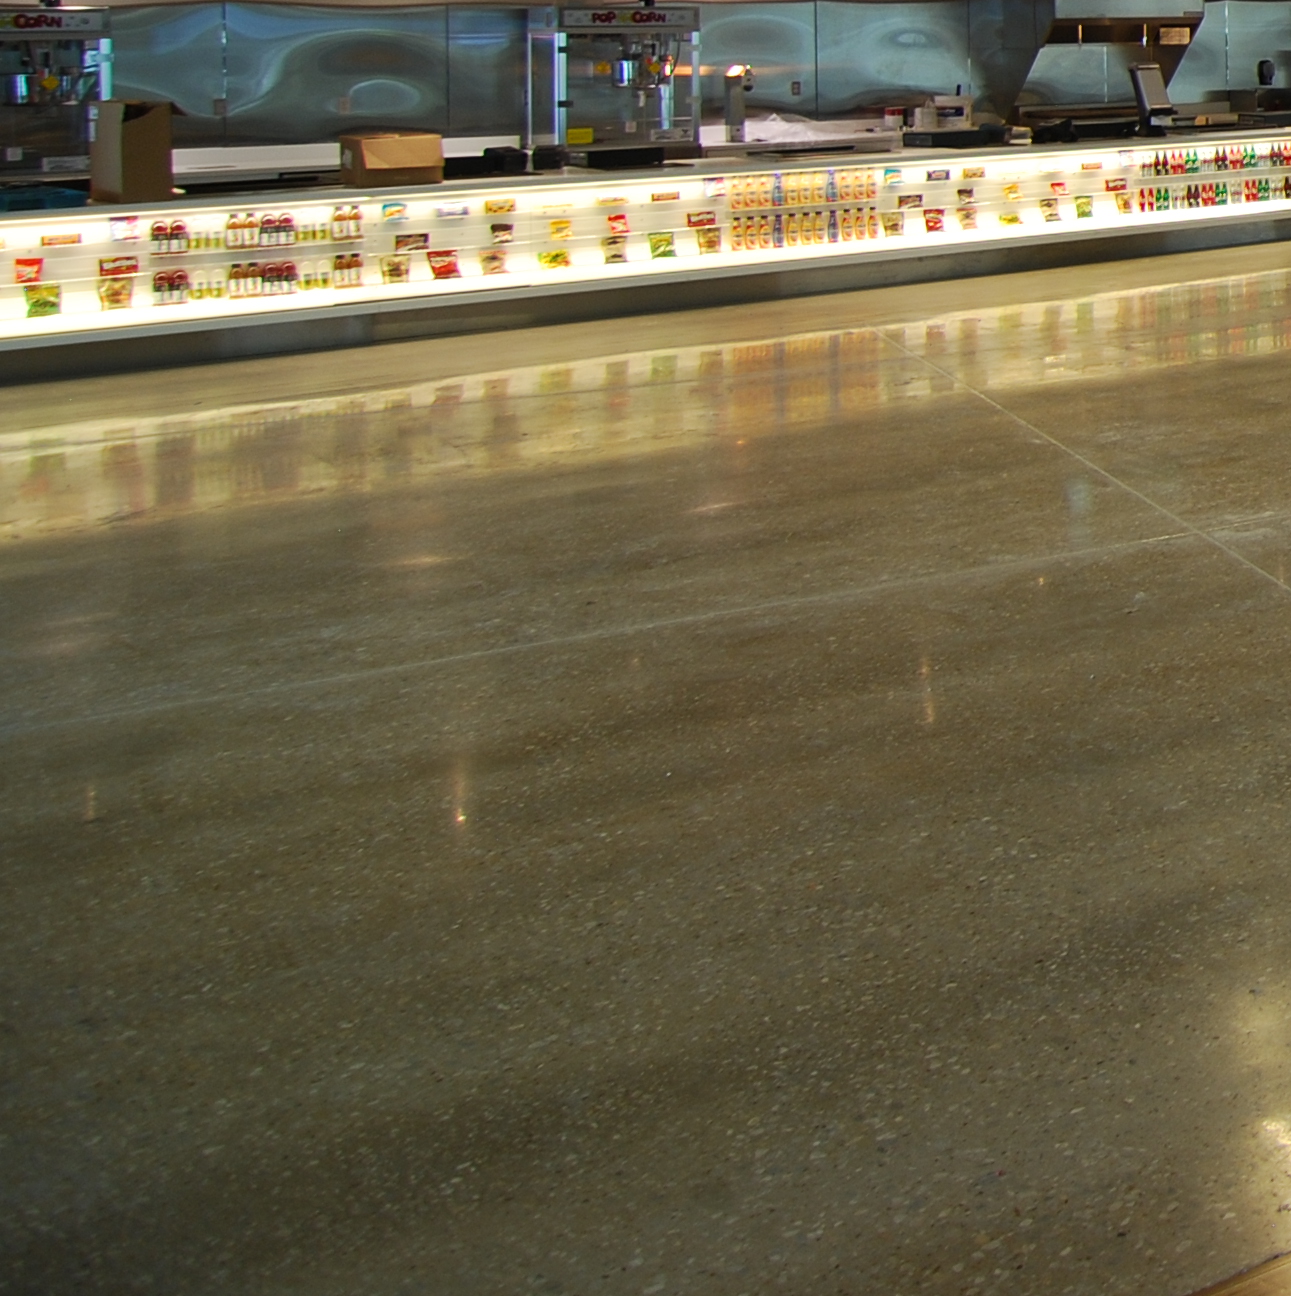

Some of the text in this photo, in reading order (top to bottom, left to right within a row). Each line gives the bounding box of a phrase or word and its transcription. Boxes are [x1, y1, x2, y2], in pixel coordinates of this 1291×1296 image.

[14, 14, 63, 29] CORN
[592, 11, 667, 24] POP CORN
